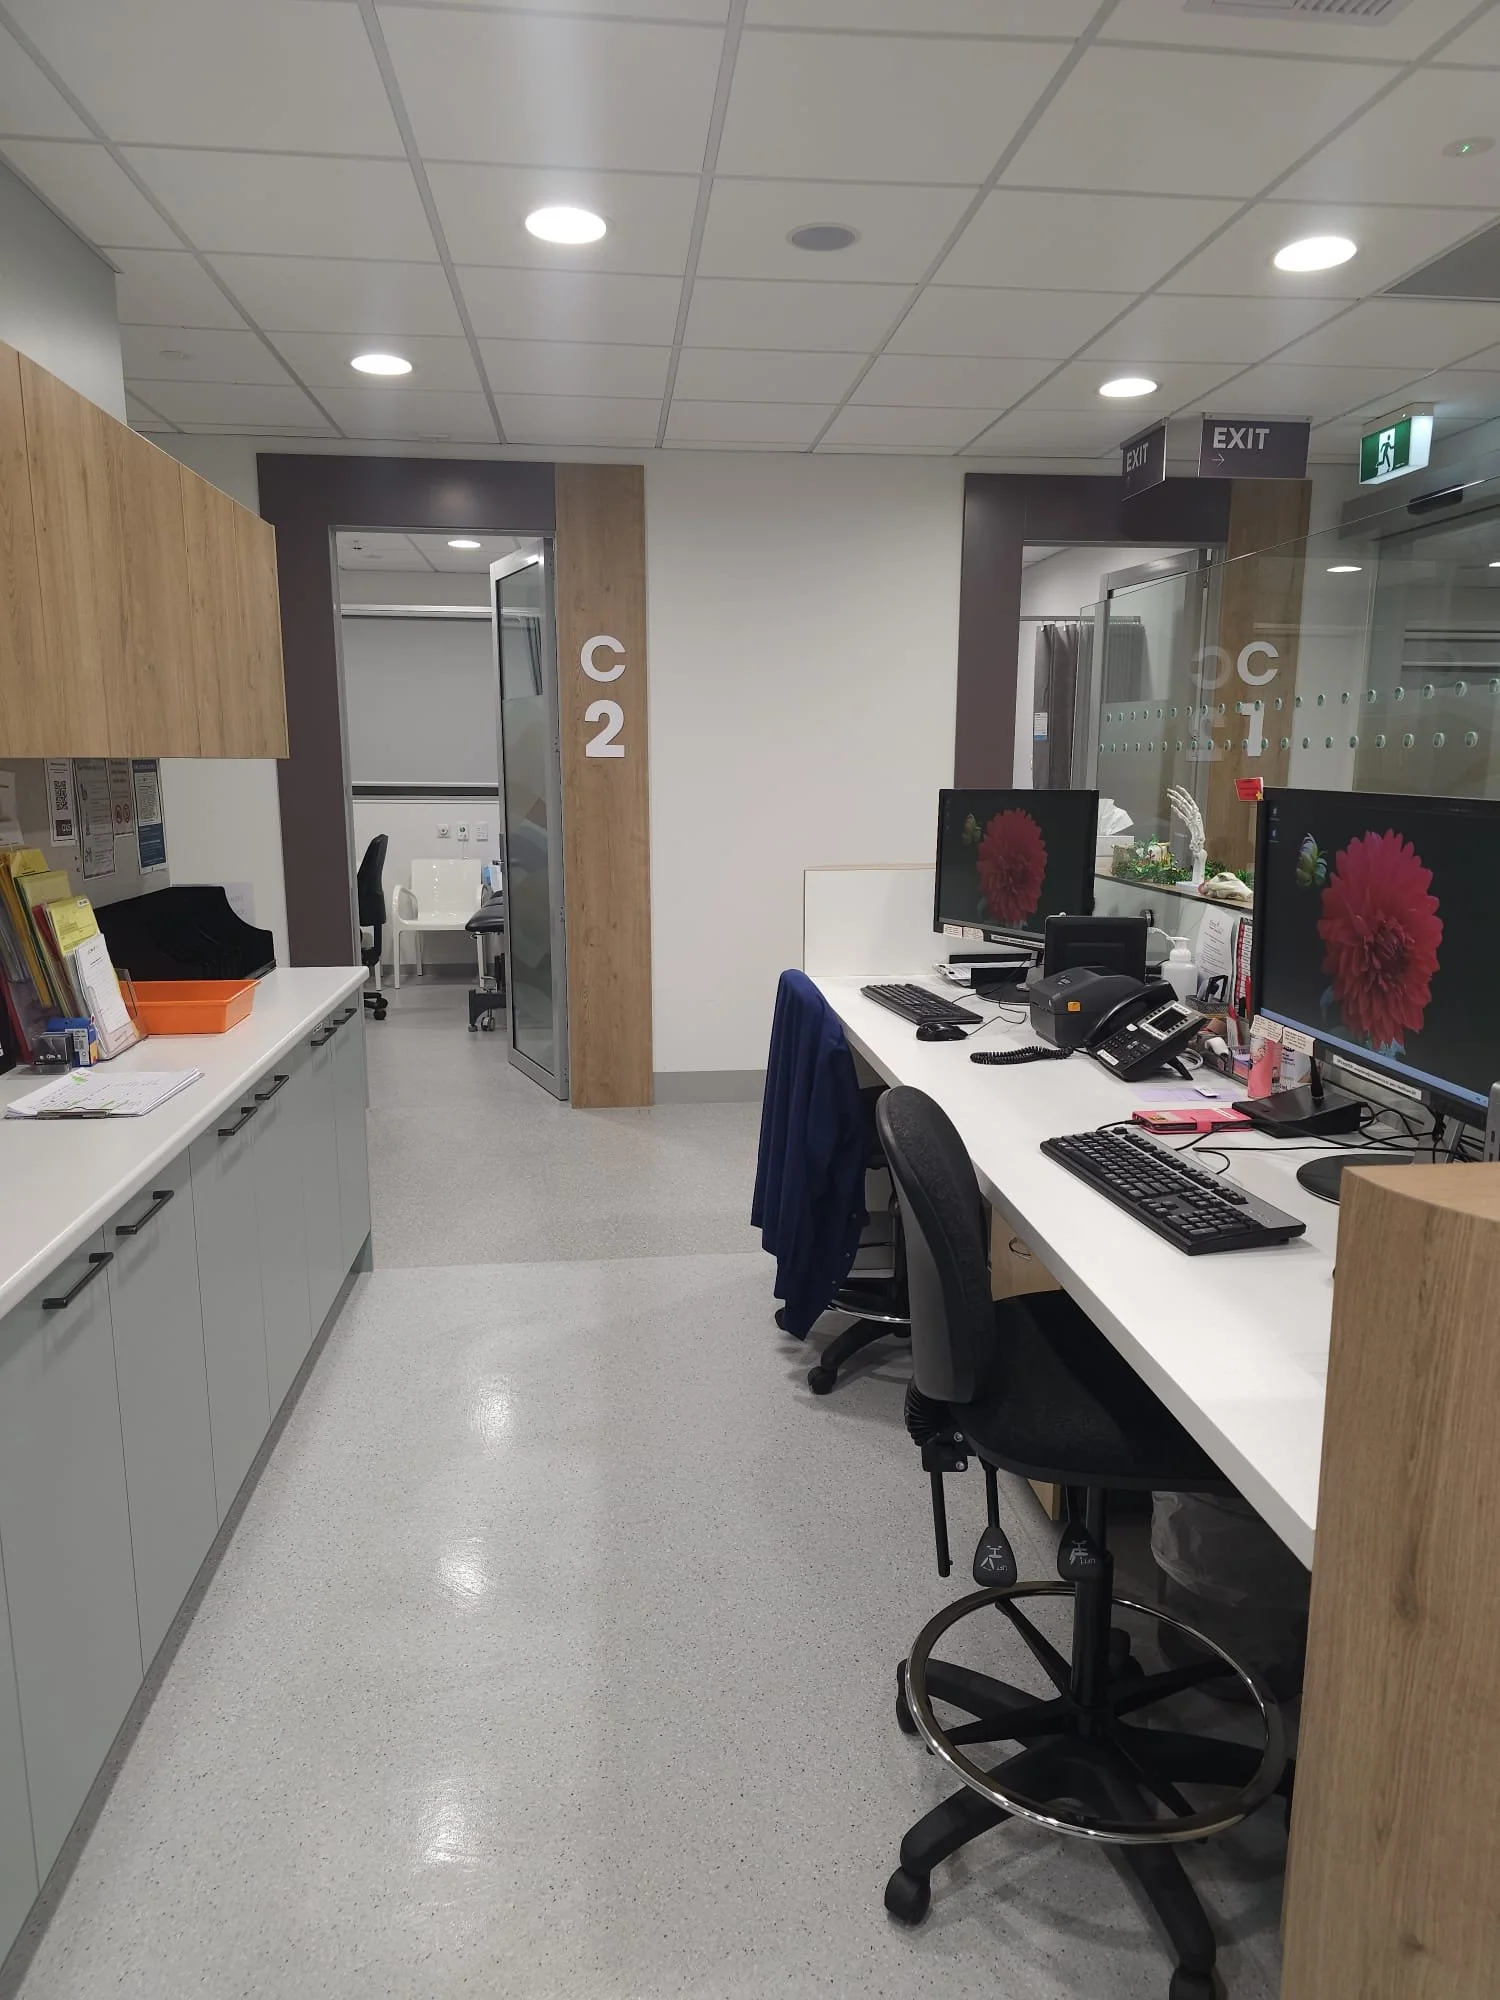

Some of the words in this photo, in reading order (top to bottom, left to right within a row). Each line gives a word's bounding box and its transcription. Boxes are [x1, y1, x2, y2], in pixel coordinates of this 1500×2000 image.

[1126, 442, 1149, 473] EXIT
[1212, 427, 1270, 450] EXIT
[580, 635, 626, 682] C
[1237, 641, 1279, 686] C
[584, 700, 625, 758] 2
[1240, 703, 1264, 757] 1
